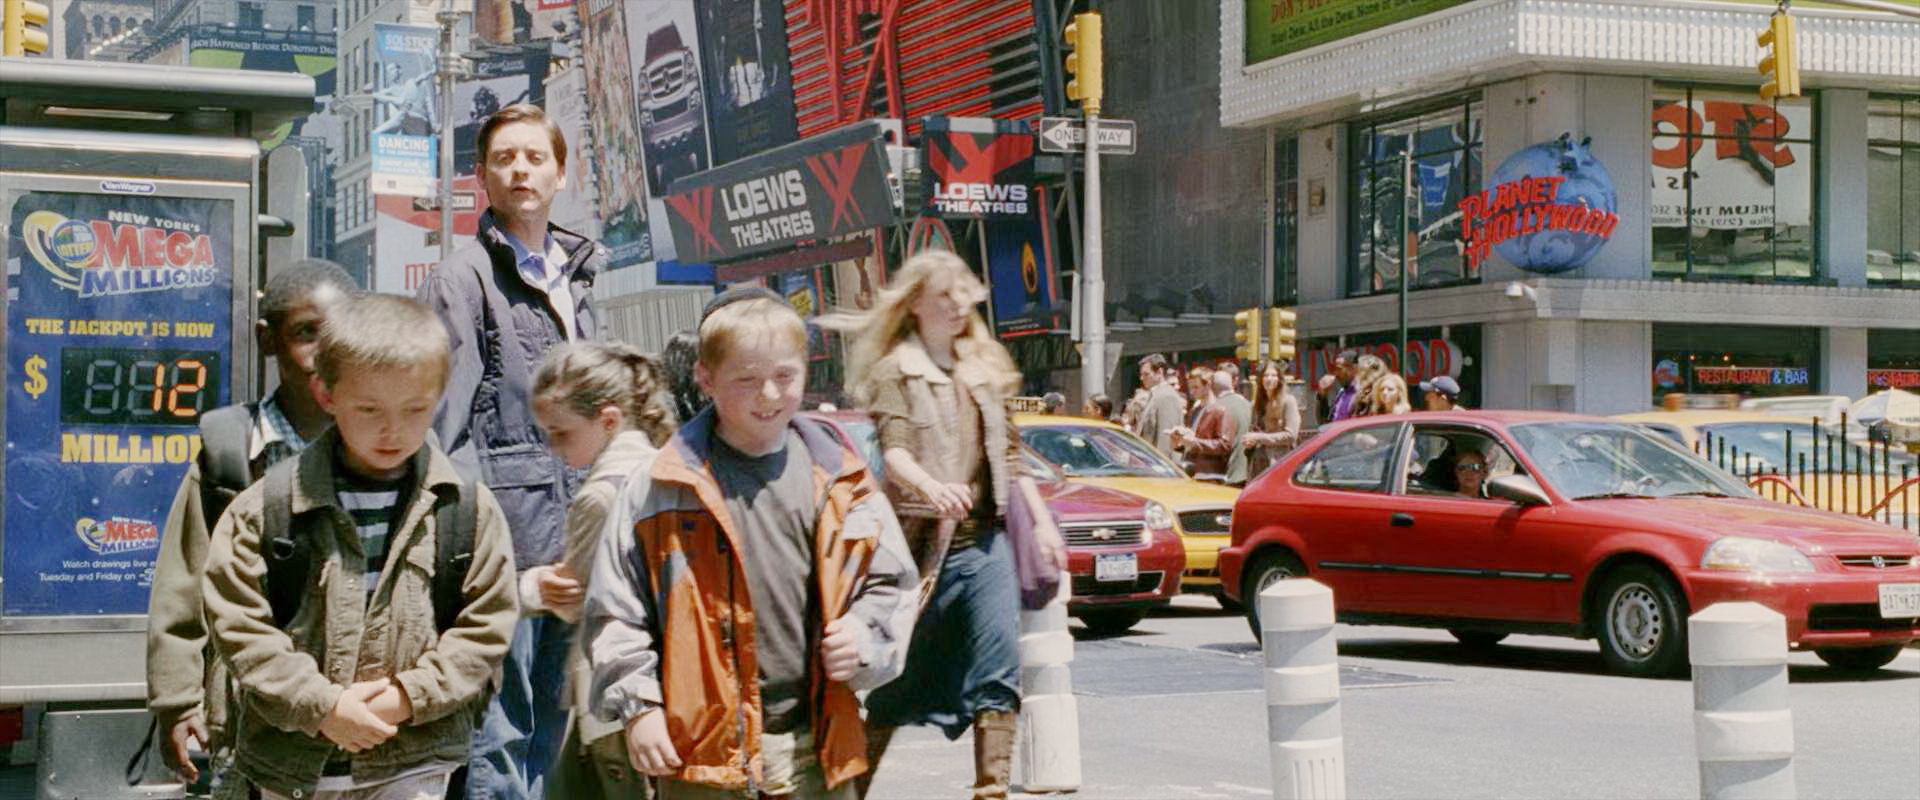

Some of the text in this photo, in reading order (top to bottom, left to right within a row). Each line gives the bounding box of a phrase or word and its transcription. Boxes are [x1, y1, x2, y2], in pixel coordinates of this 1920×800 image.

[378, 136, 429, 151] DANCING
[1054, 128, 1123, 142] ONE WAY
[720, 168, 806, 221] LOEWS
[933, 183, 1027, 201] LOEWS
[935, 200, 1027, 214] THEATRES
[1457, 176, 1565, 239] PLANET
[107, 210, 201, 232] NEW YORK'S
[730, 209, 815, 248] THEATRES
[90, 219, 213, 268] MEGA
[1468, 203, 1621, 270] HOLLYWOOD
[79, 267, 216, 297] MILLIONS
[25, 318, 214, 338] THE JACKPOT IS NOW
[1697, 368, 1771, 384] RESTAURANT
[1772, 368, 1782, 384] &
[1784, 368, 1809, 384] BAR
[103, 519, 158, 542] MEGA
[62, 559, 90, 569] Watch
[92, 560, 131, 570] drawings
[133, 560, 147, 568] live
[39, 572, 75, 583] Tuesday
[77, 573, 94, 581] and
[95, 572, 121, 583] Friday
